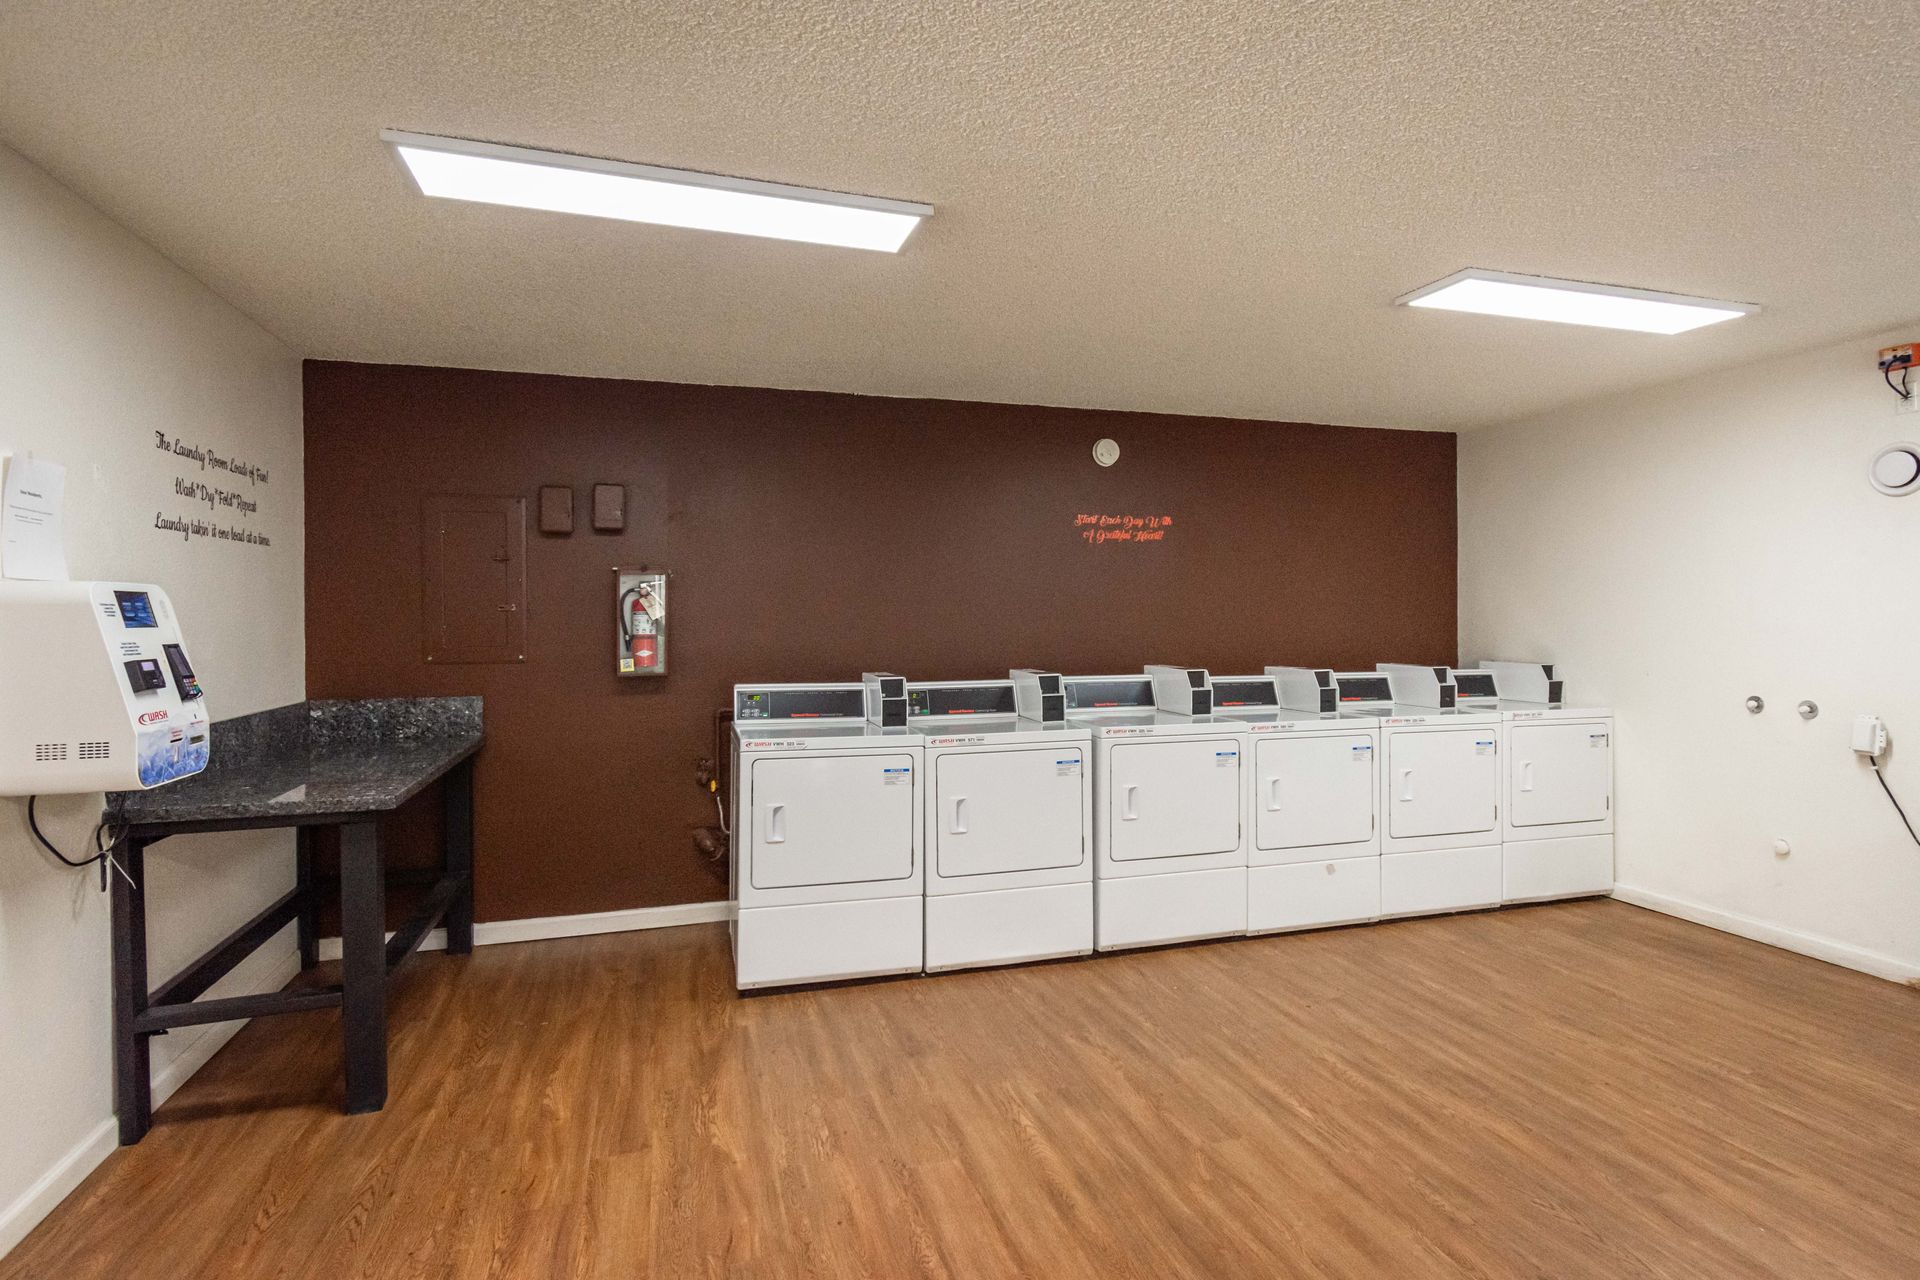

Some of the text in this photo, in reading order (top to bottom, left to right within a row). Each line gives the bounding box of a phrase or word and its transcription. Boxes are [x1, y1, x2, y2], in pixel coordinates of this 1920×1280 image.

[155, 430, 269, 486] The Laundry Room Loads of Fun!
[155, 511, 189, 541] Laundry
[191, 519, 210, 539] takin'
[212, 523, 217, 538] it
[218, 528, 230, 540] one
[231, 526, 245, 543] load
[246, 531, 253, 545] at
[1074, 513, 1098, 526] Start
[1100, 515, 1121, 526] Each
[1123, 515, 1144, 529] Day
[1083, 528, 1095, 543] A
[1096, 529, 1132, 544] Grateful
[148, 710, 169, 722] WASH
